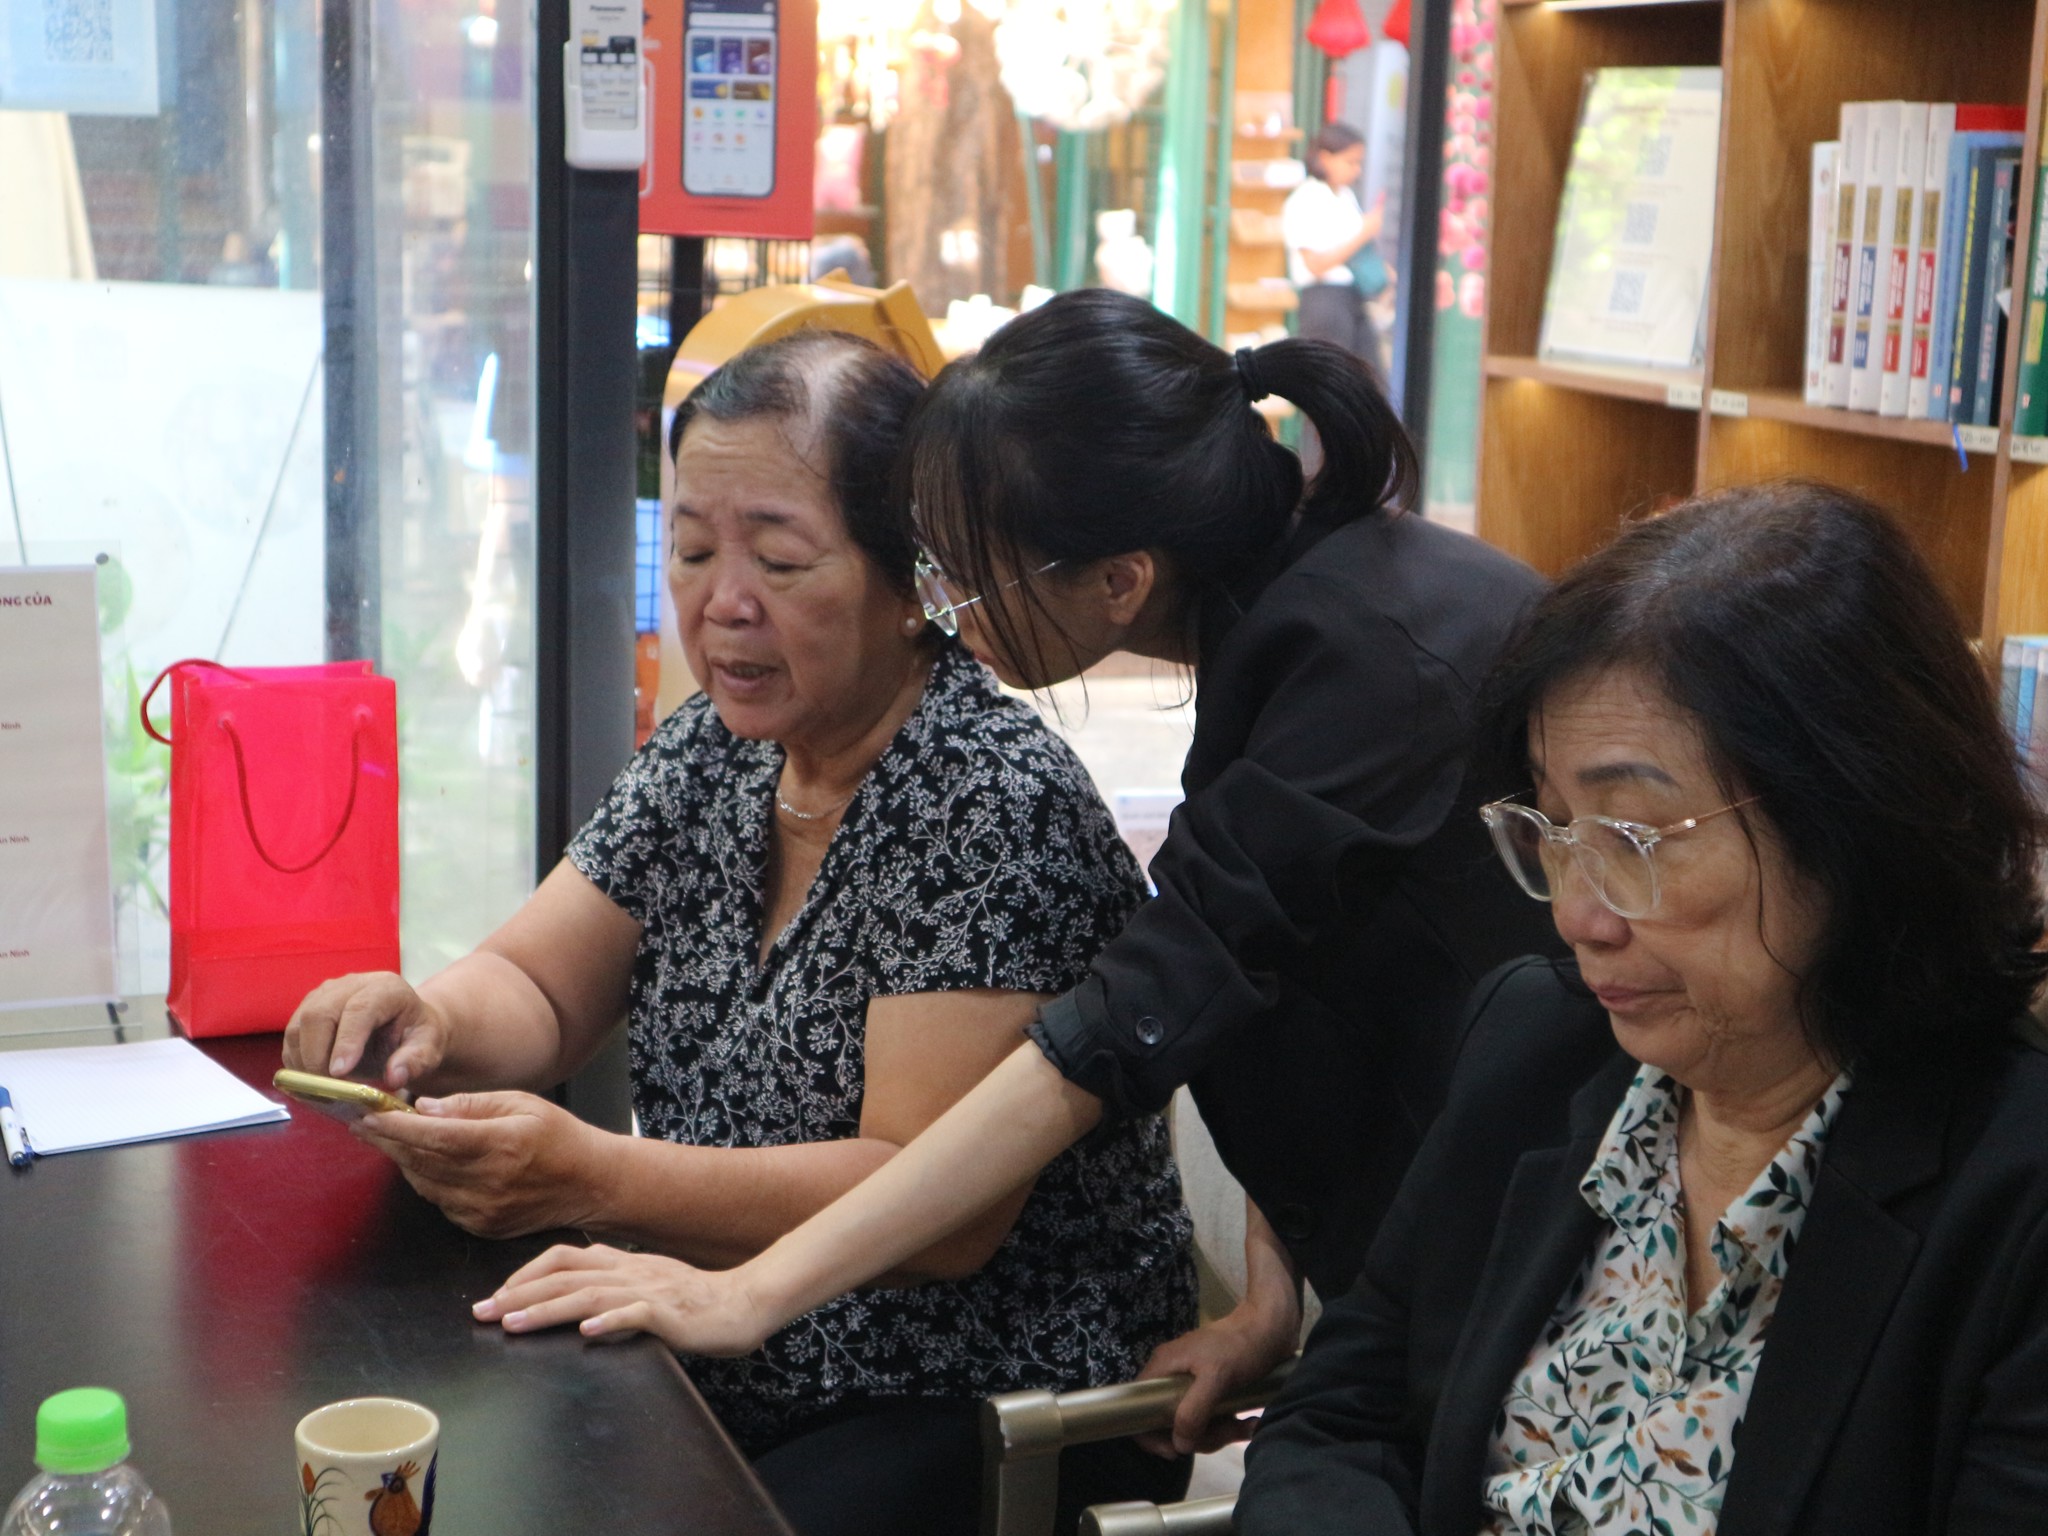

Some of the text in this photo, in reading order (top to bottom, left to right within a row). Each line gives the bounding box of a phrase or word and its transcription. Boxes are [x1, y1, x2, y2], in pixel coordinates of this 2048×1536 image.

[24, 591, 52, 606] CỦA
[10, 835, 30, 844] Ninh
[10, 949, 30, 958] Ninh
